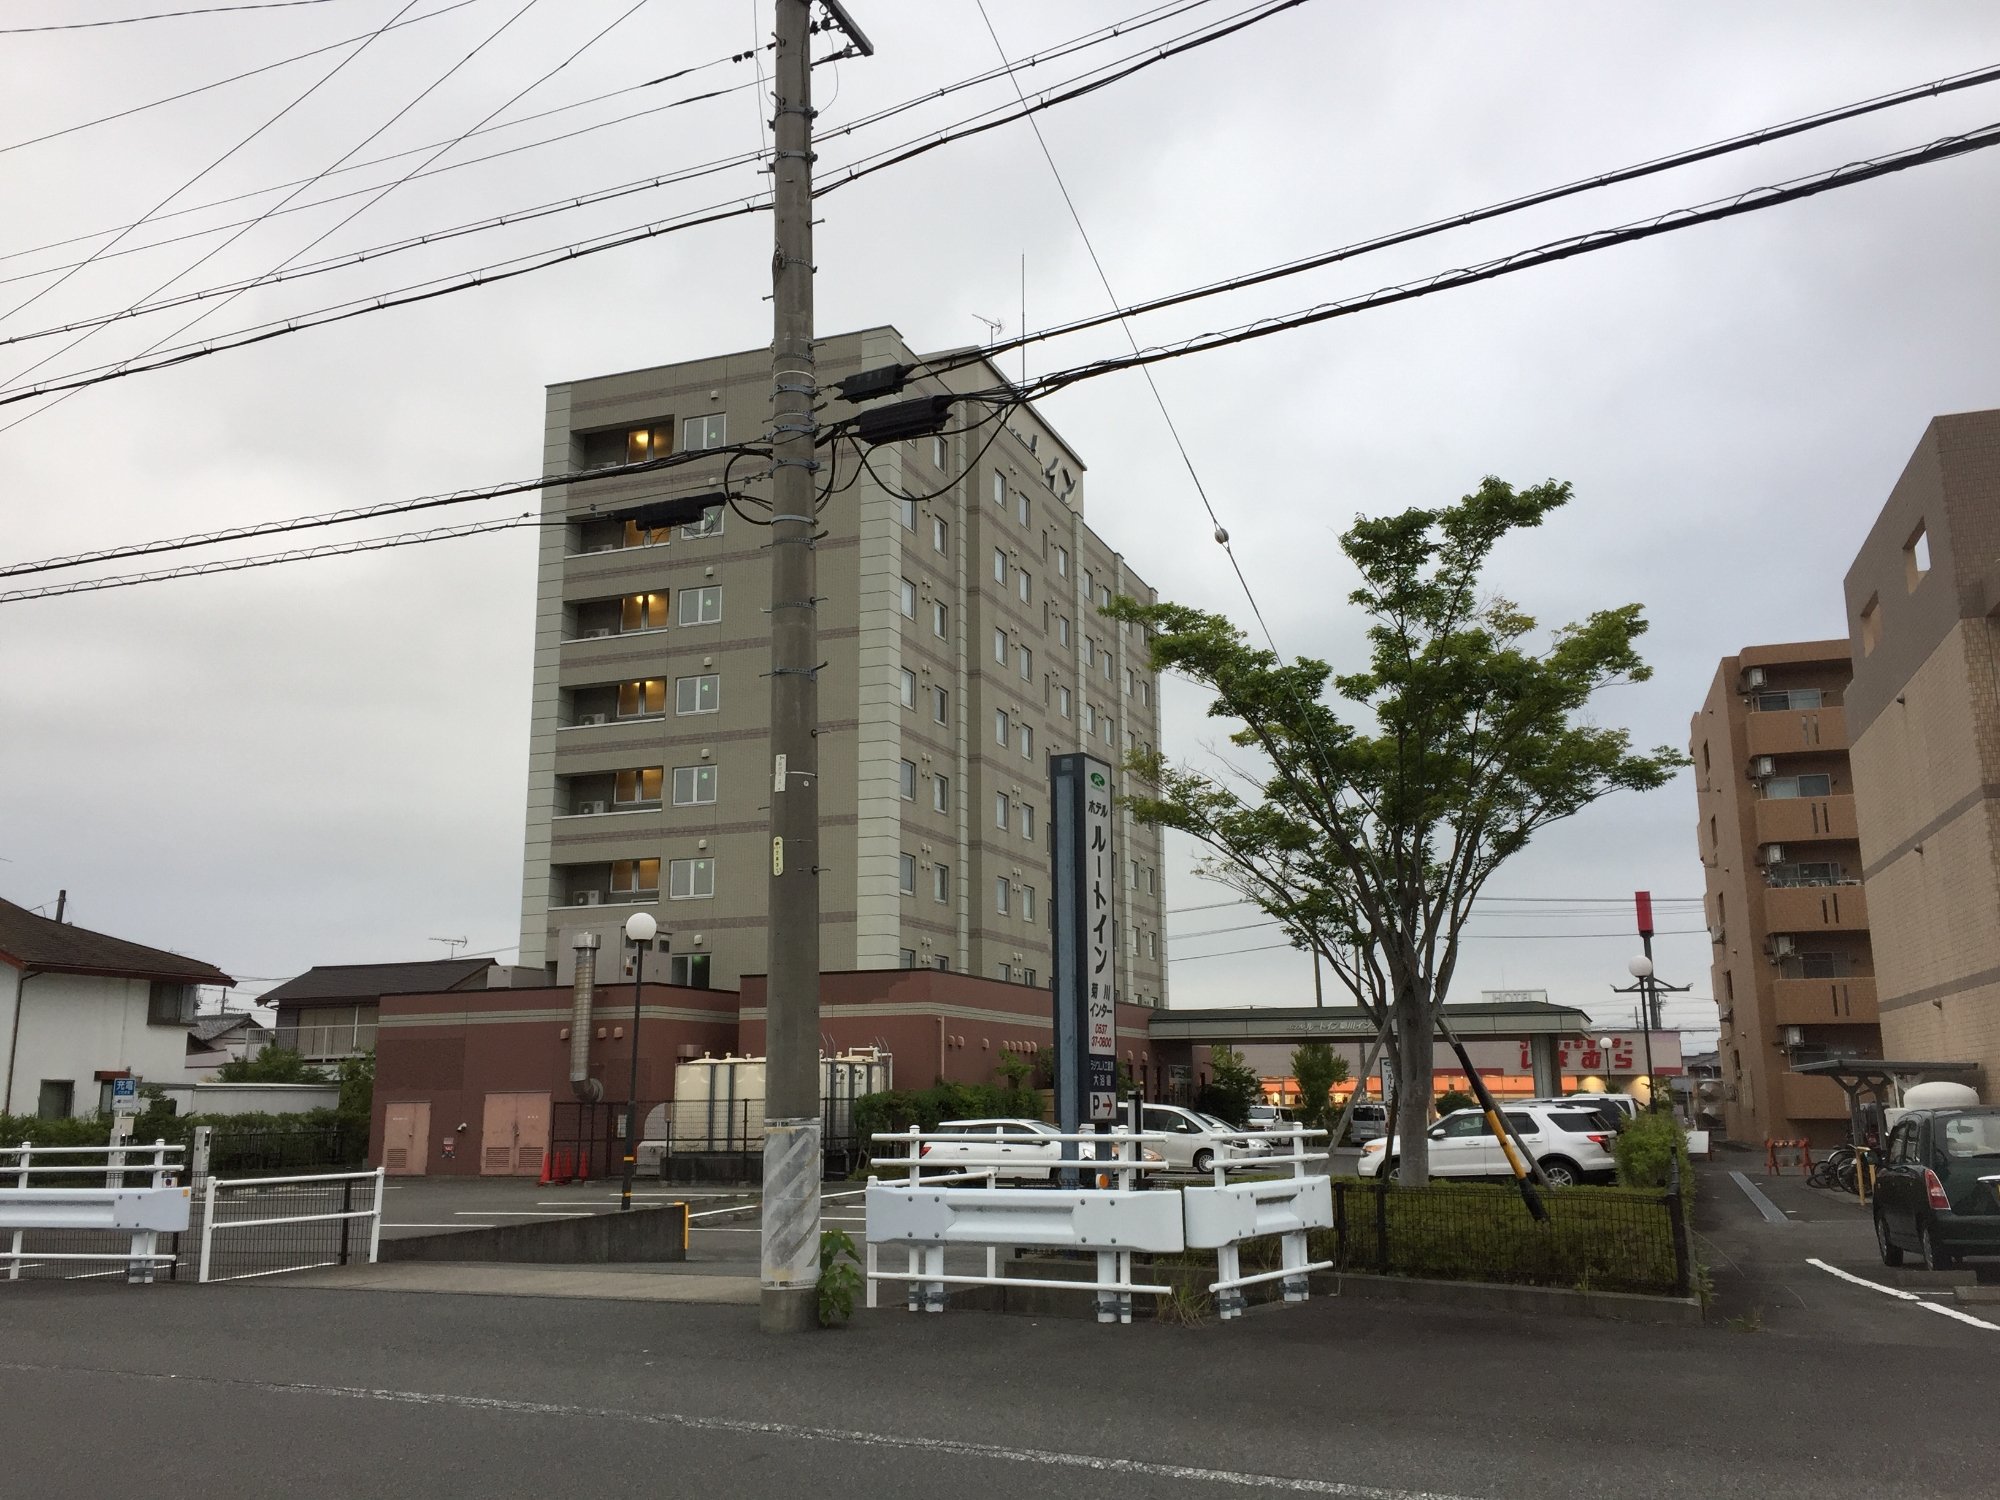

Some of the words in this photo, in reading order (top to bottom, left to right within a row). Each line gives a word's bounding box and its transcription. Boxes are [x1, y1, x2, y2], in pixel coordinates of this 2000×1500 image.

[1088, 799, 1108, 818] ホテル
[1092, 825, 1107, 974] ルートイン
[1090, 1002, 1112, 1018] インター
[1092, 1094, 1100, 1116] P
